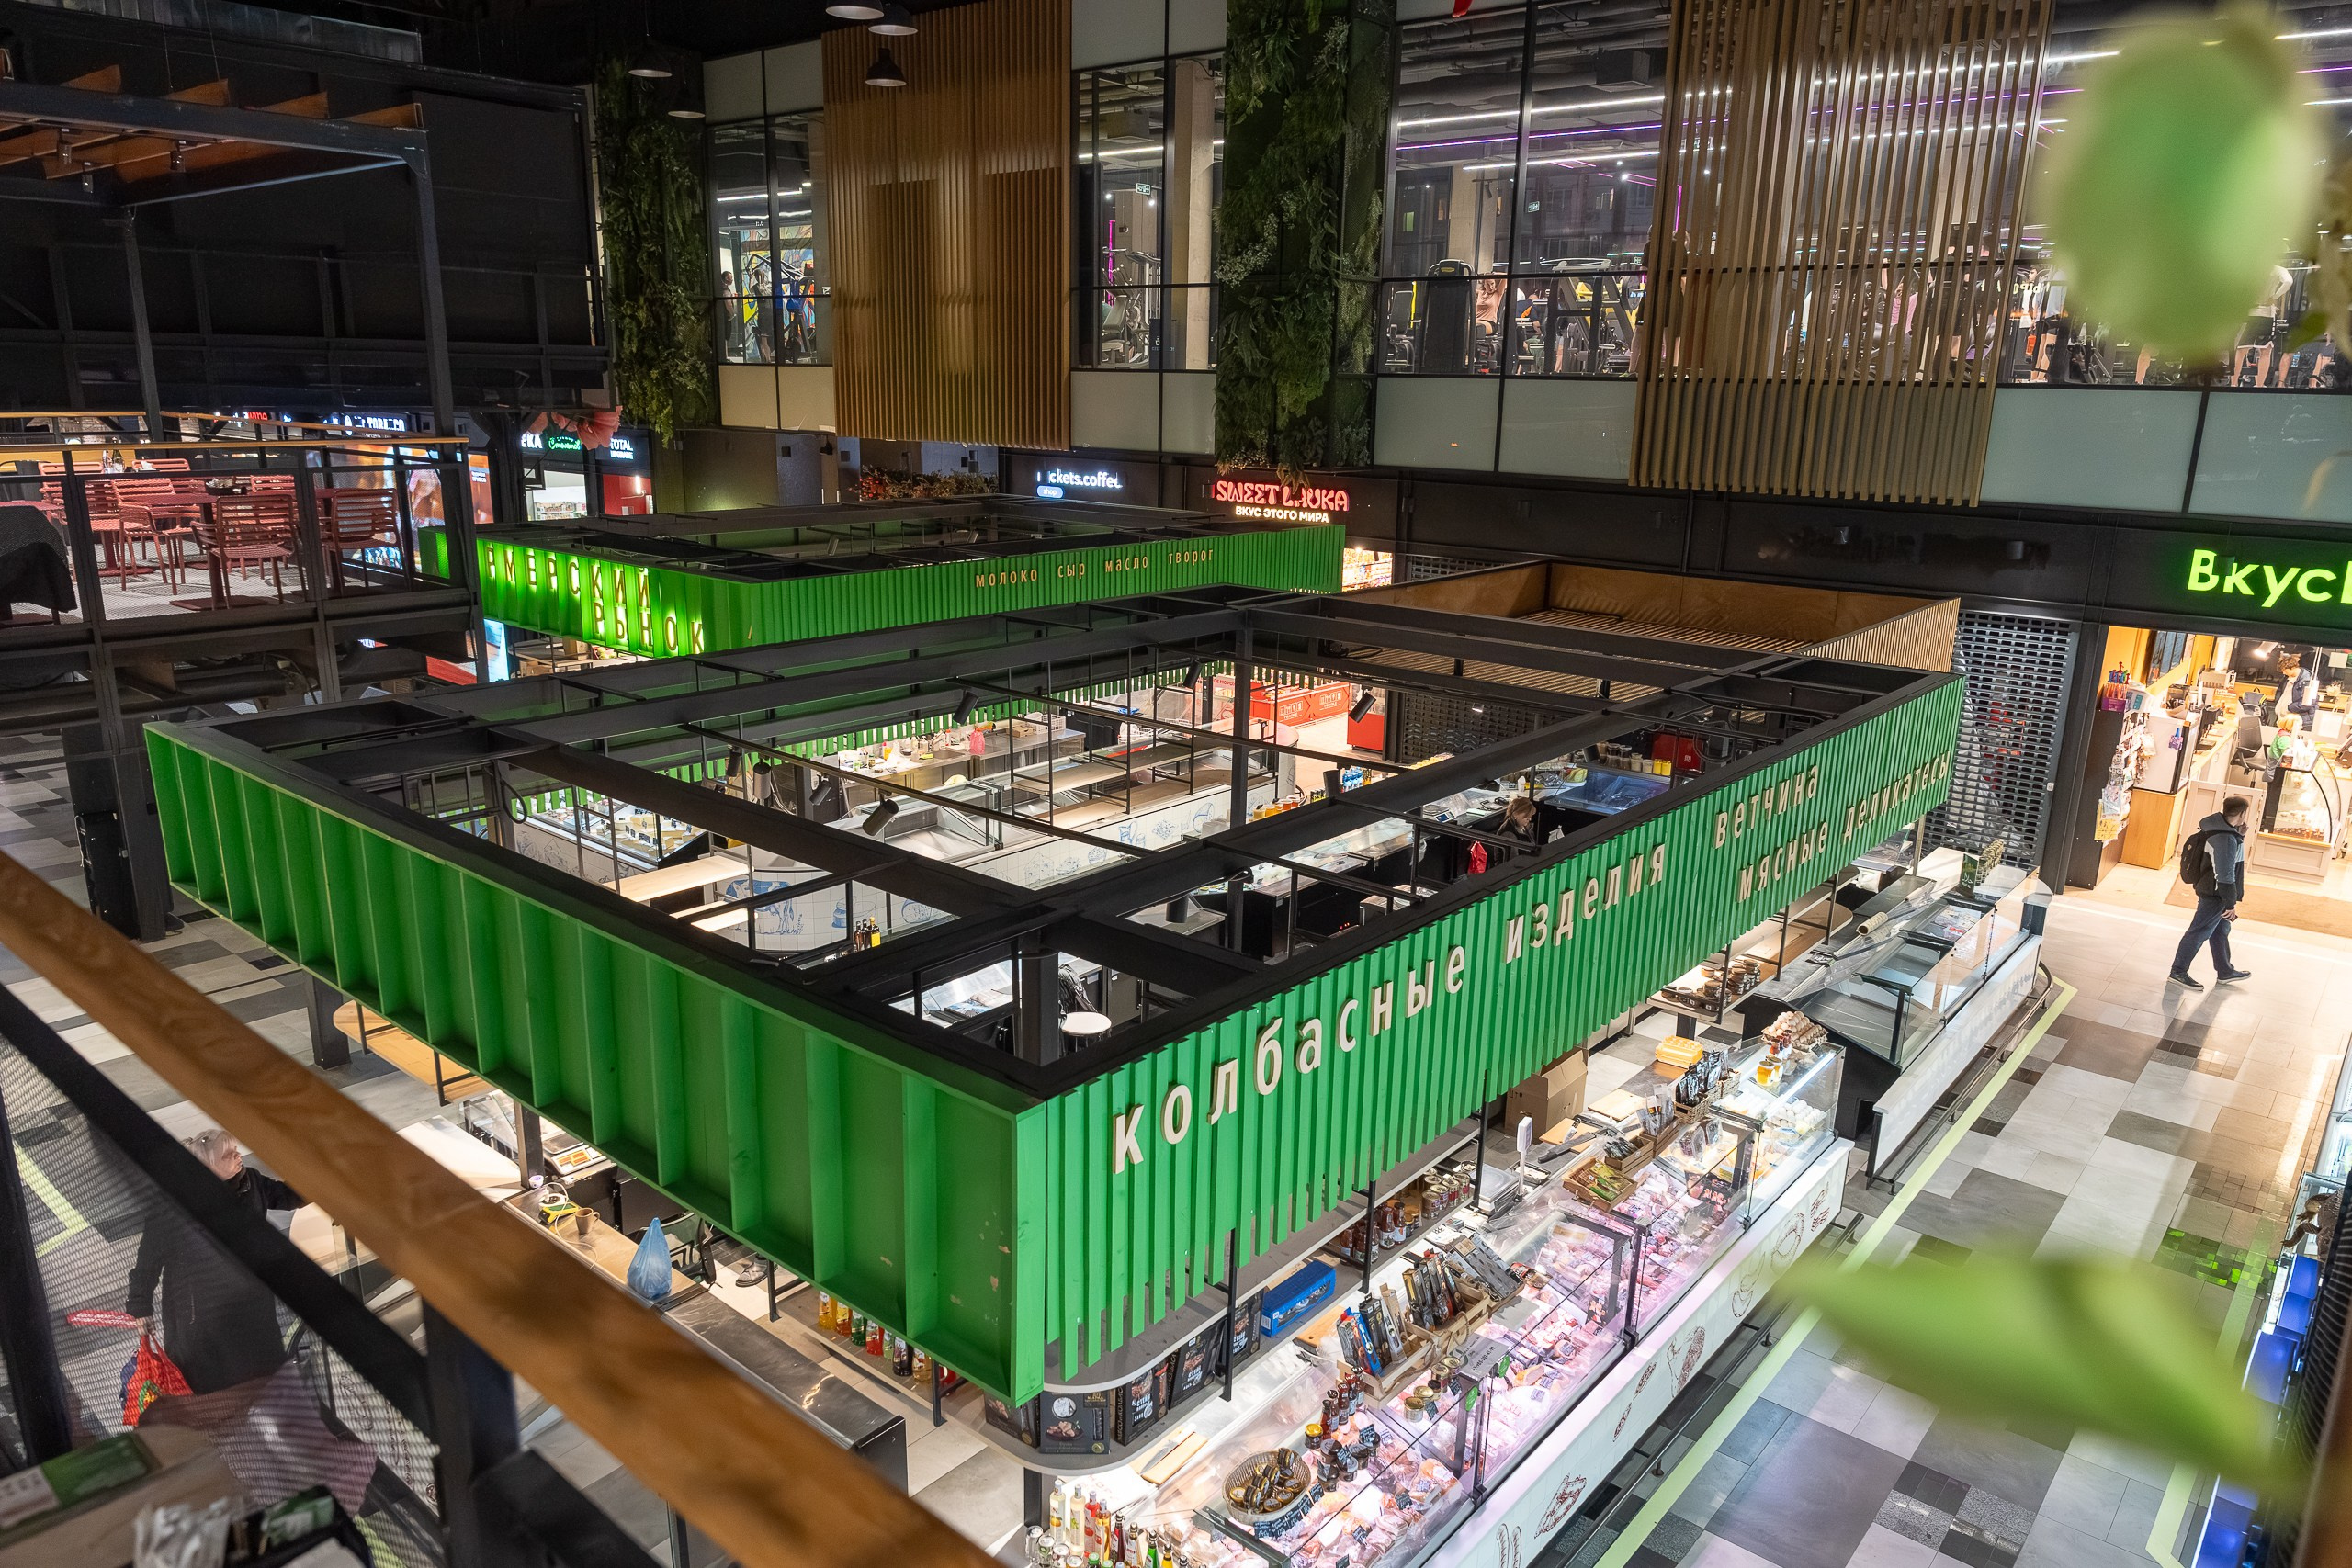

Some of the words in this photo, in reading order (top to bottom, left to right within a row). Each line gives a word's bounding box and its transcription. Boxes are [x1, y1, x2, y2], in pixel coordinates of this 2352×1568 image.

[610, 438, 634, 451] TOTAL
[1043, 488, 1057, 496] shop
[1216, 480, 1280, 504] SWEET
[1235, 505, 1262, 517] ВКУС
[1263, 508, 1298, 521] ЭТОГО
[1298, 512, 1329, 524] МИРА
[976, 569, 1037, 588] молоко
[1057, 562, 1085, 579] сыр
[1105, 556, 1148, 572] масло
[1169, 548, 1214, 566] творог
[2187, 548, 2352, 608] Вкус
[594, 602, 705, 655] РЫНОК
[1736, 820, 1829, 903] мясные
[1842, 750, 1951, 846] деликатесы
[1112, 944, 1465, 1175] колбасные
[1503, 843, 1666, 964] изделия
[1714, 762, 1819, 850] ветчина
